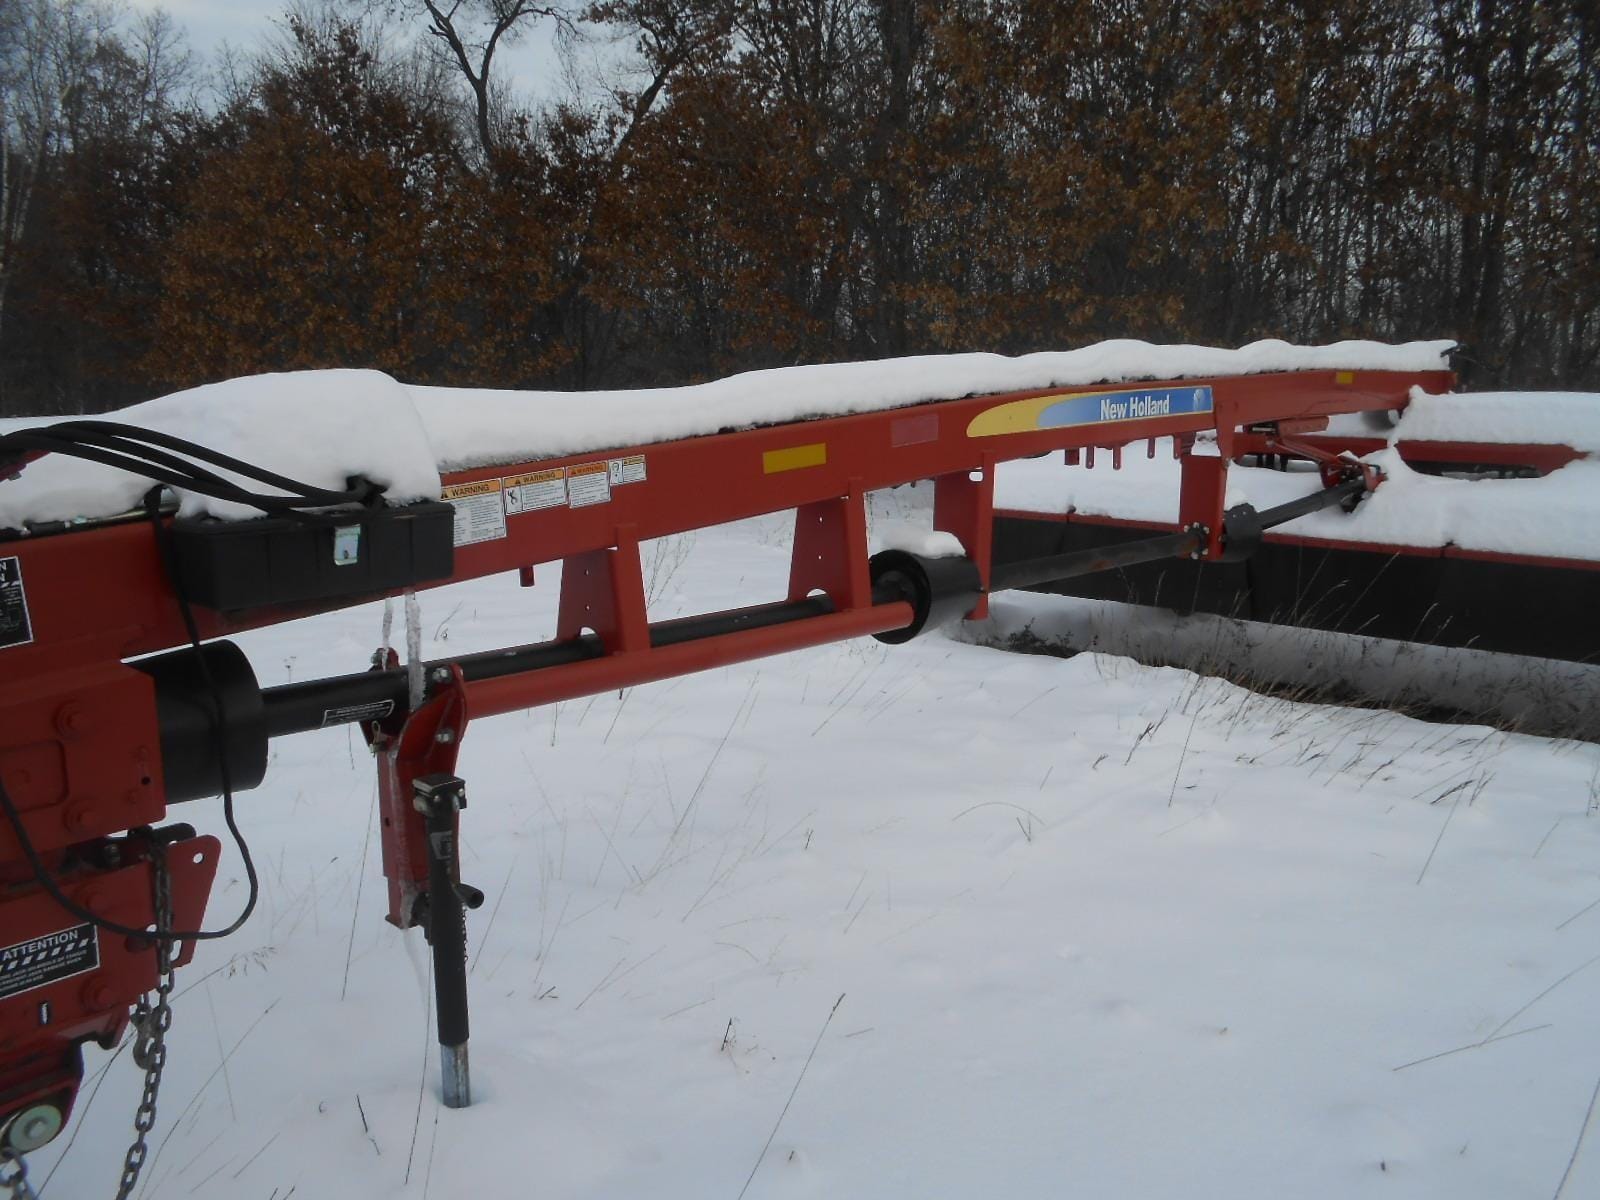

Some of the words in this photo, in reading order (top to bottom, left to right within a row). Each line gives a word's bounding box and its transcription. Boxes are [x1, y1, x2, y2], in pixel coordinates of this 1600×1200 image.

[1100, 398, 1127, 421] New
[1129, 394, 1170, 418] Holland
[523, 471, 556, 484] WARNING
[451, 483, 490, 497] WARNING
[3, 929, 79, 961] ATTENTION
